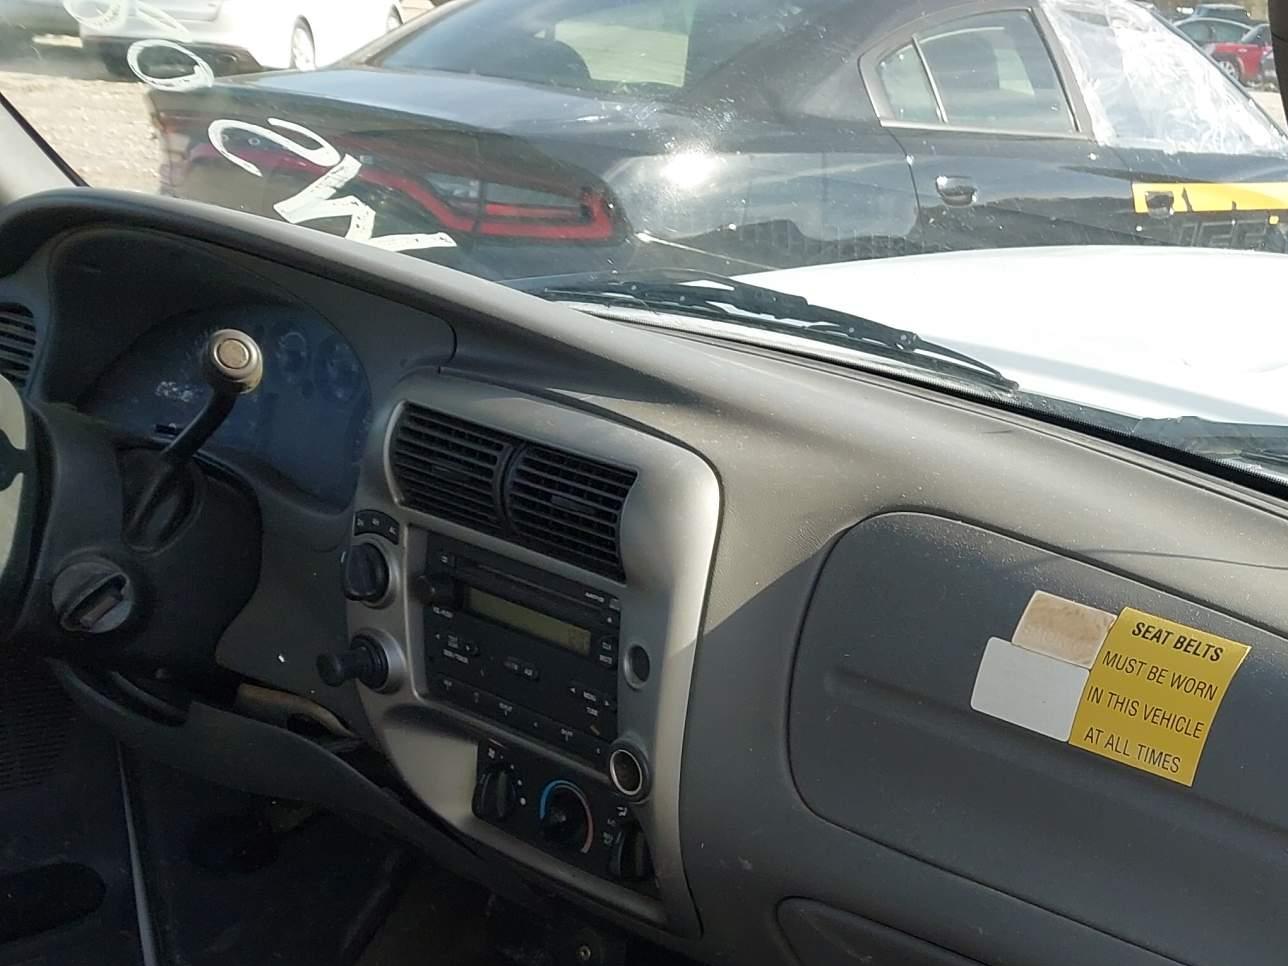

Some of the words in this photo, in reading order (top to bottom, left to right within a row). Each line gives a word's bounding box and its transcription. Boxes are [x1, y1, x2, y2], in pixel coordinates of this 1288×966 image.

[1131, 622, 1173, 646] SEAT
[1172, 635, 1224, 662] BELTS
[1102, 650, 1147, 677] MUST
[1146, 665, 1169, 685] BE
[1169, 672, 1219, 701] WORN
[1086, 685, 1104, 705] IN
[1106, 691, 1141, 717] THIS
[1142, 703, 1205, 739] VEHICLE
[1083, 727, 1104, 744] AT
[1103, 734, 1131, 757] ALL
[1136, 743, 1182, 774] TIMES
